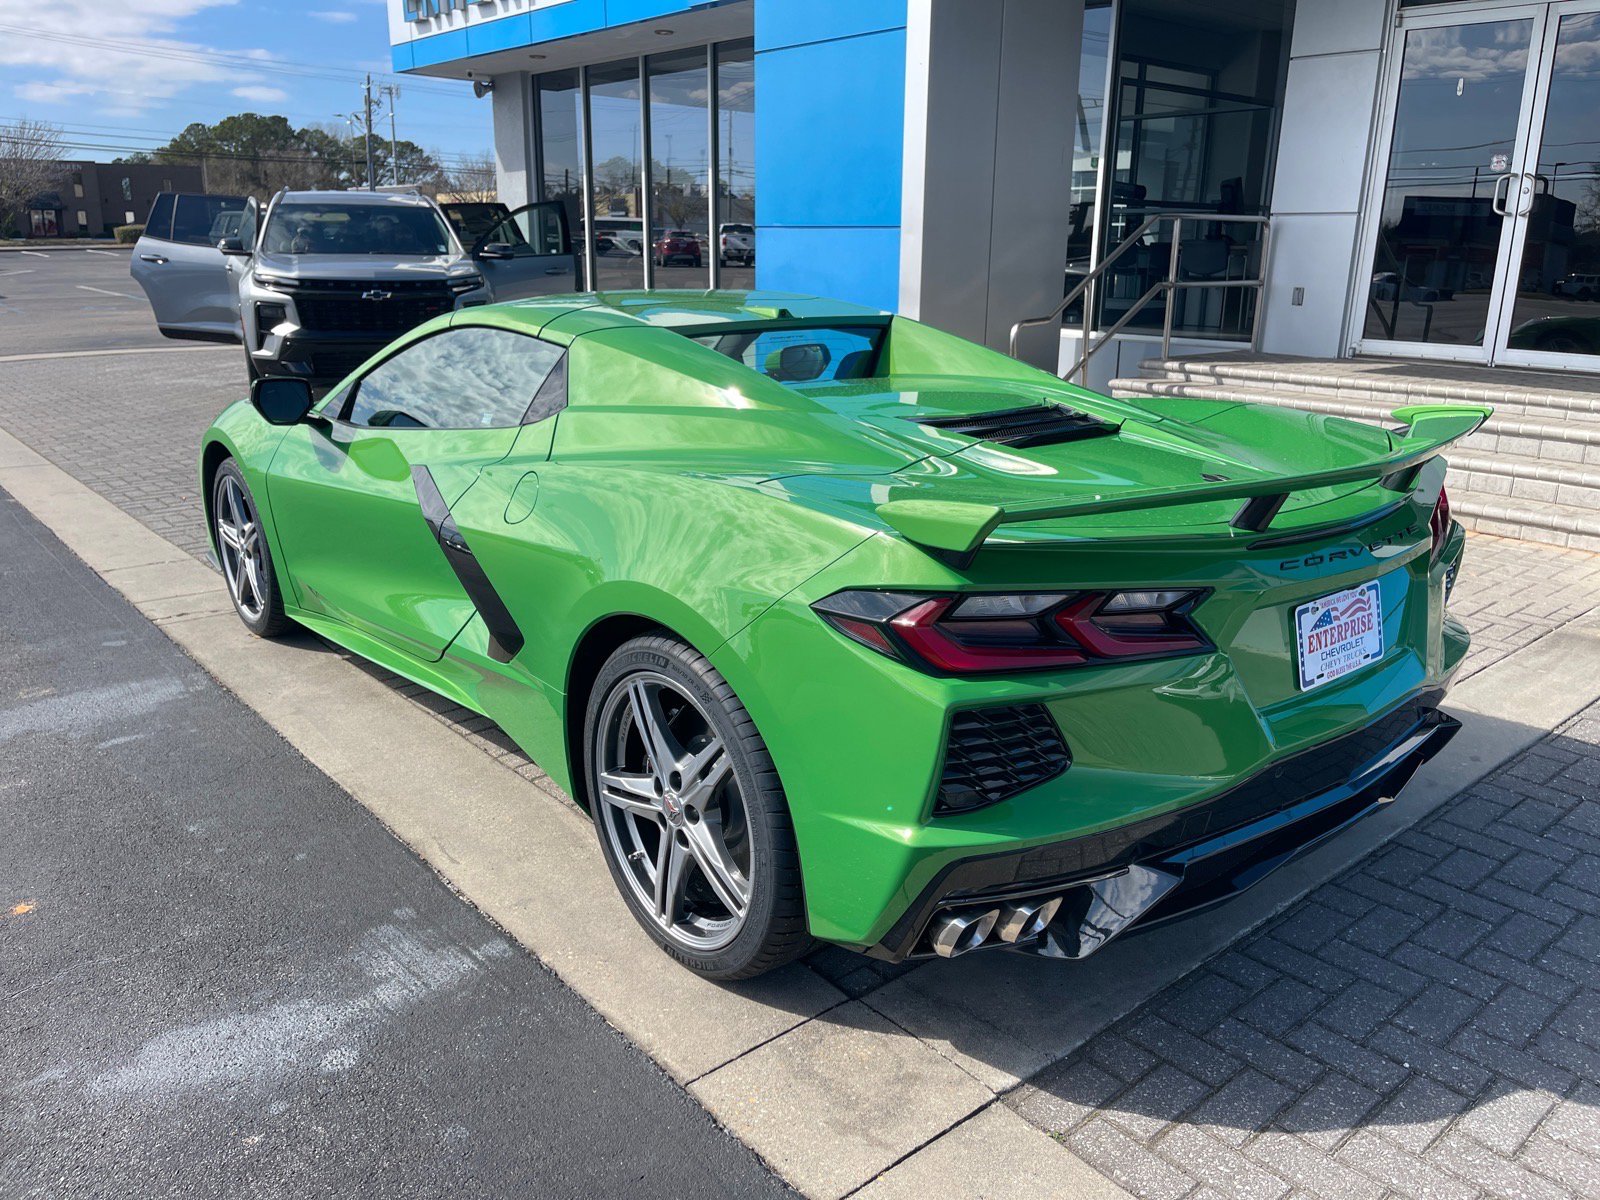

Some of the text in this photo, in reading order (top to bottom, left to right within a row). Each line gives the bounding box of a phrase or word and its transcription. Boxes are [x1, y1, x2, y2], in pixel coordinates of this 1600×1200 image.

[1280, 524, 1420, 571] CORVETTE
[1307, 612, 1374, 654] ENTERPRISE
[620, 652, 667, 668] MICHELIN
[1320, 636, 1364, 661] CHEVROLET
[1320, 647, 1367, 672] CHEVY TRUCKS
